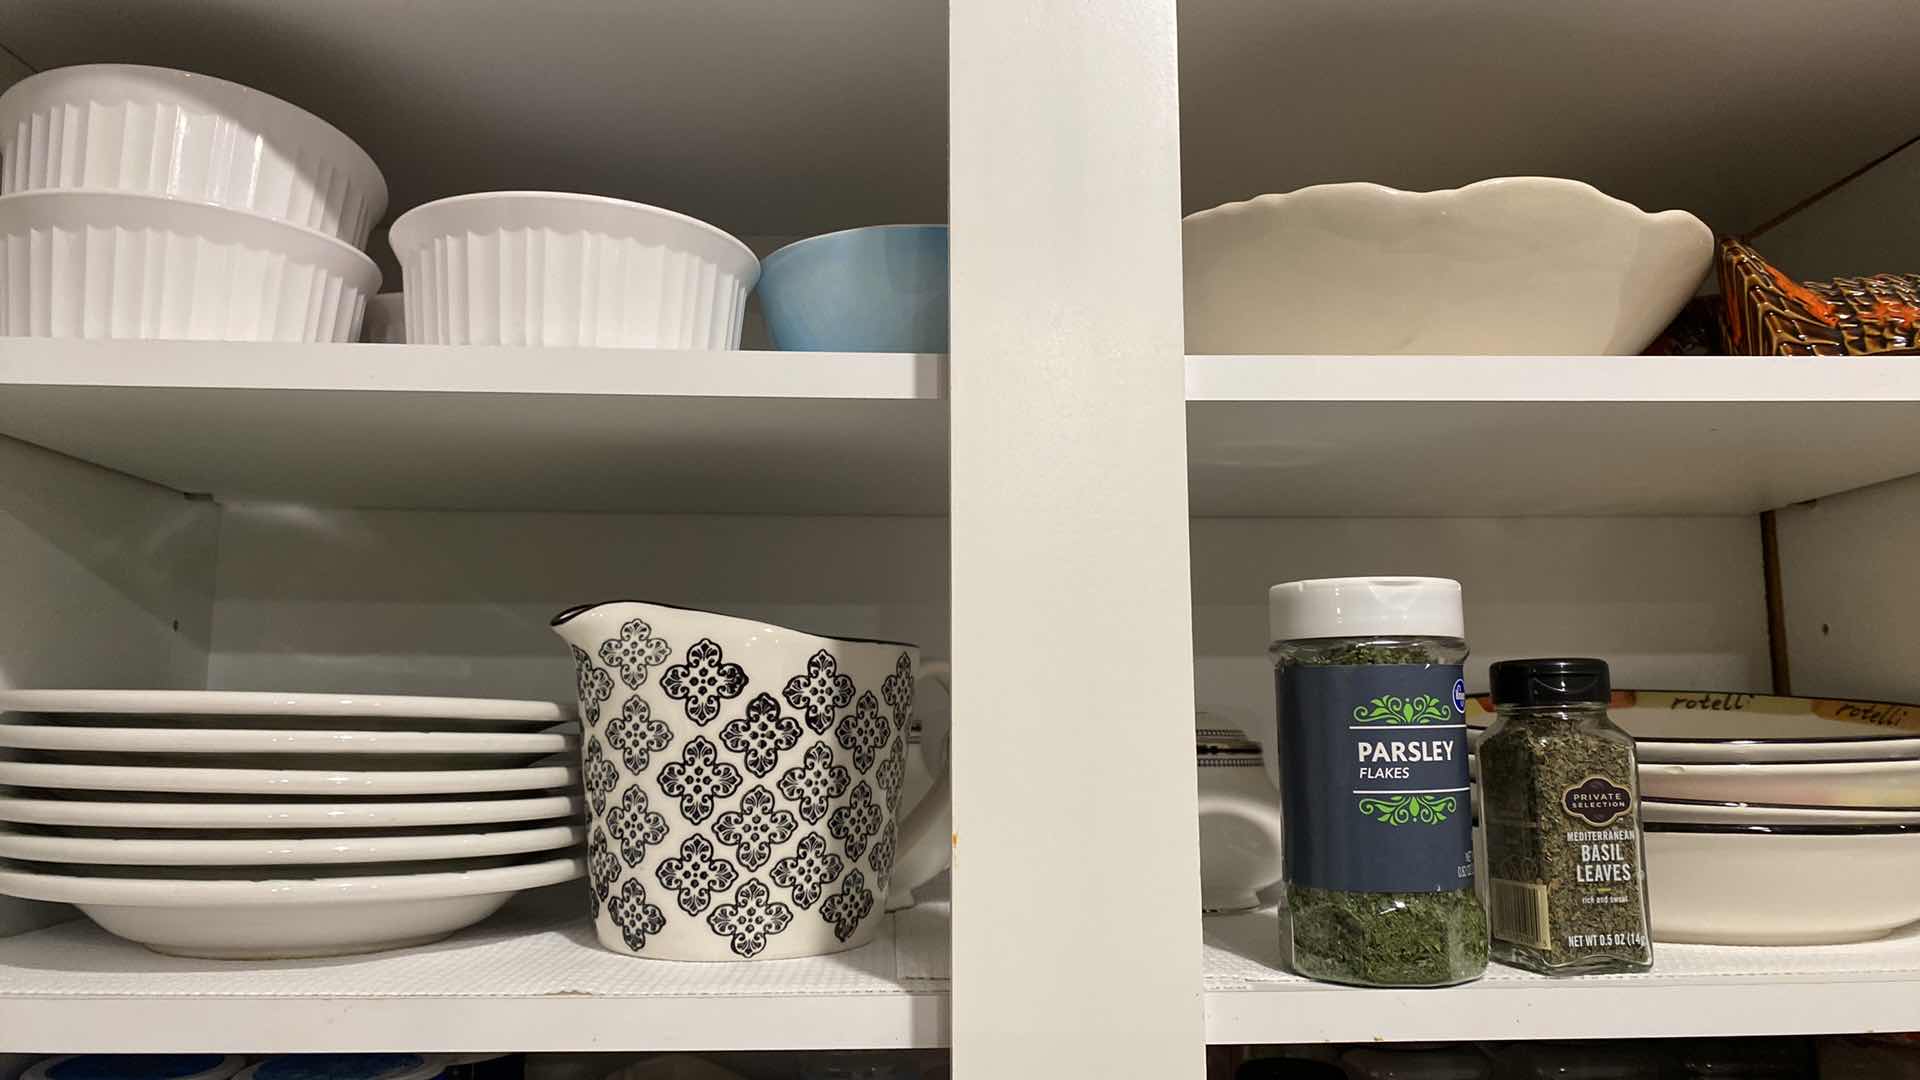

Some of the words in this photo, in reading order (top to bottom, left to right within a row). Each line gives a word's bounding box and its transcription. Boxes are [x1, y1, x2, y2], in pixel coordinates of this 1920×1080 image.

[1358, 740, 1454, 762] PARSLEY
[1359, 767, 1410, 779] FLAKES
[1573, 793, 1622, 801] PRIVATE
[1572, 801, 1625, 809] SELECTION
[1566, 830, 1635, 842] MEDITERRANEAN
[1581, 843, 1625, 862] BASIL
[1576, 863, 1632, 883] LEAVES
[1582, 896, 1595, 904] rich
[1568, 935, 1584, 948] NET
[1585, 934, 1598, 947] WT
[1599, 934, 1613, 947] 0.5
[1614, 933, 1626, 946] OZ
